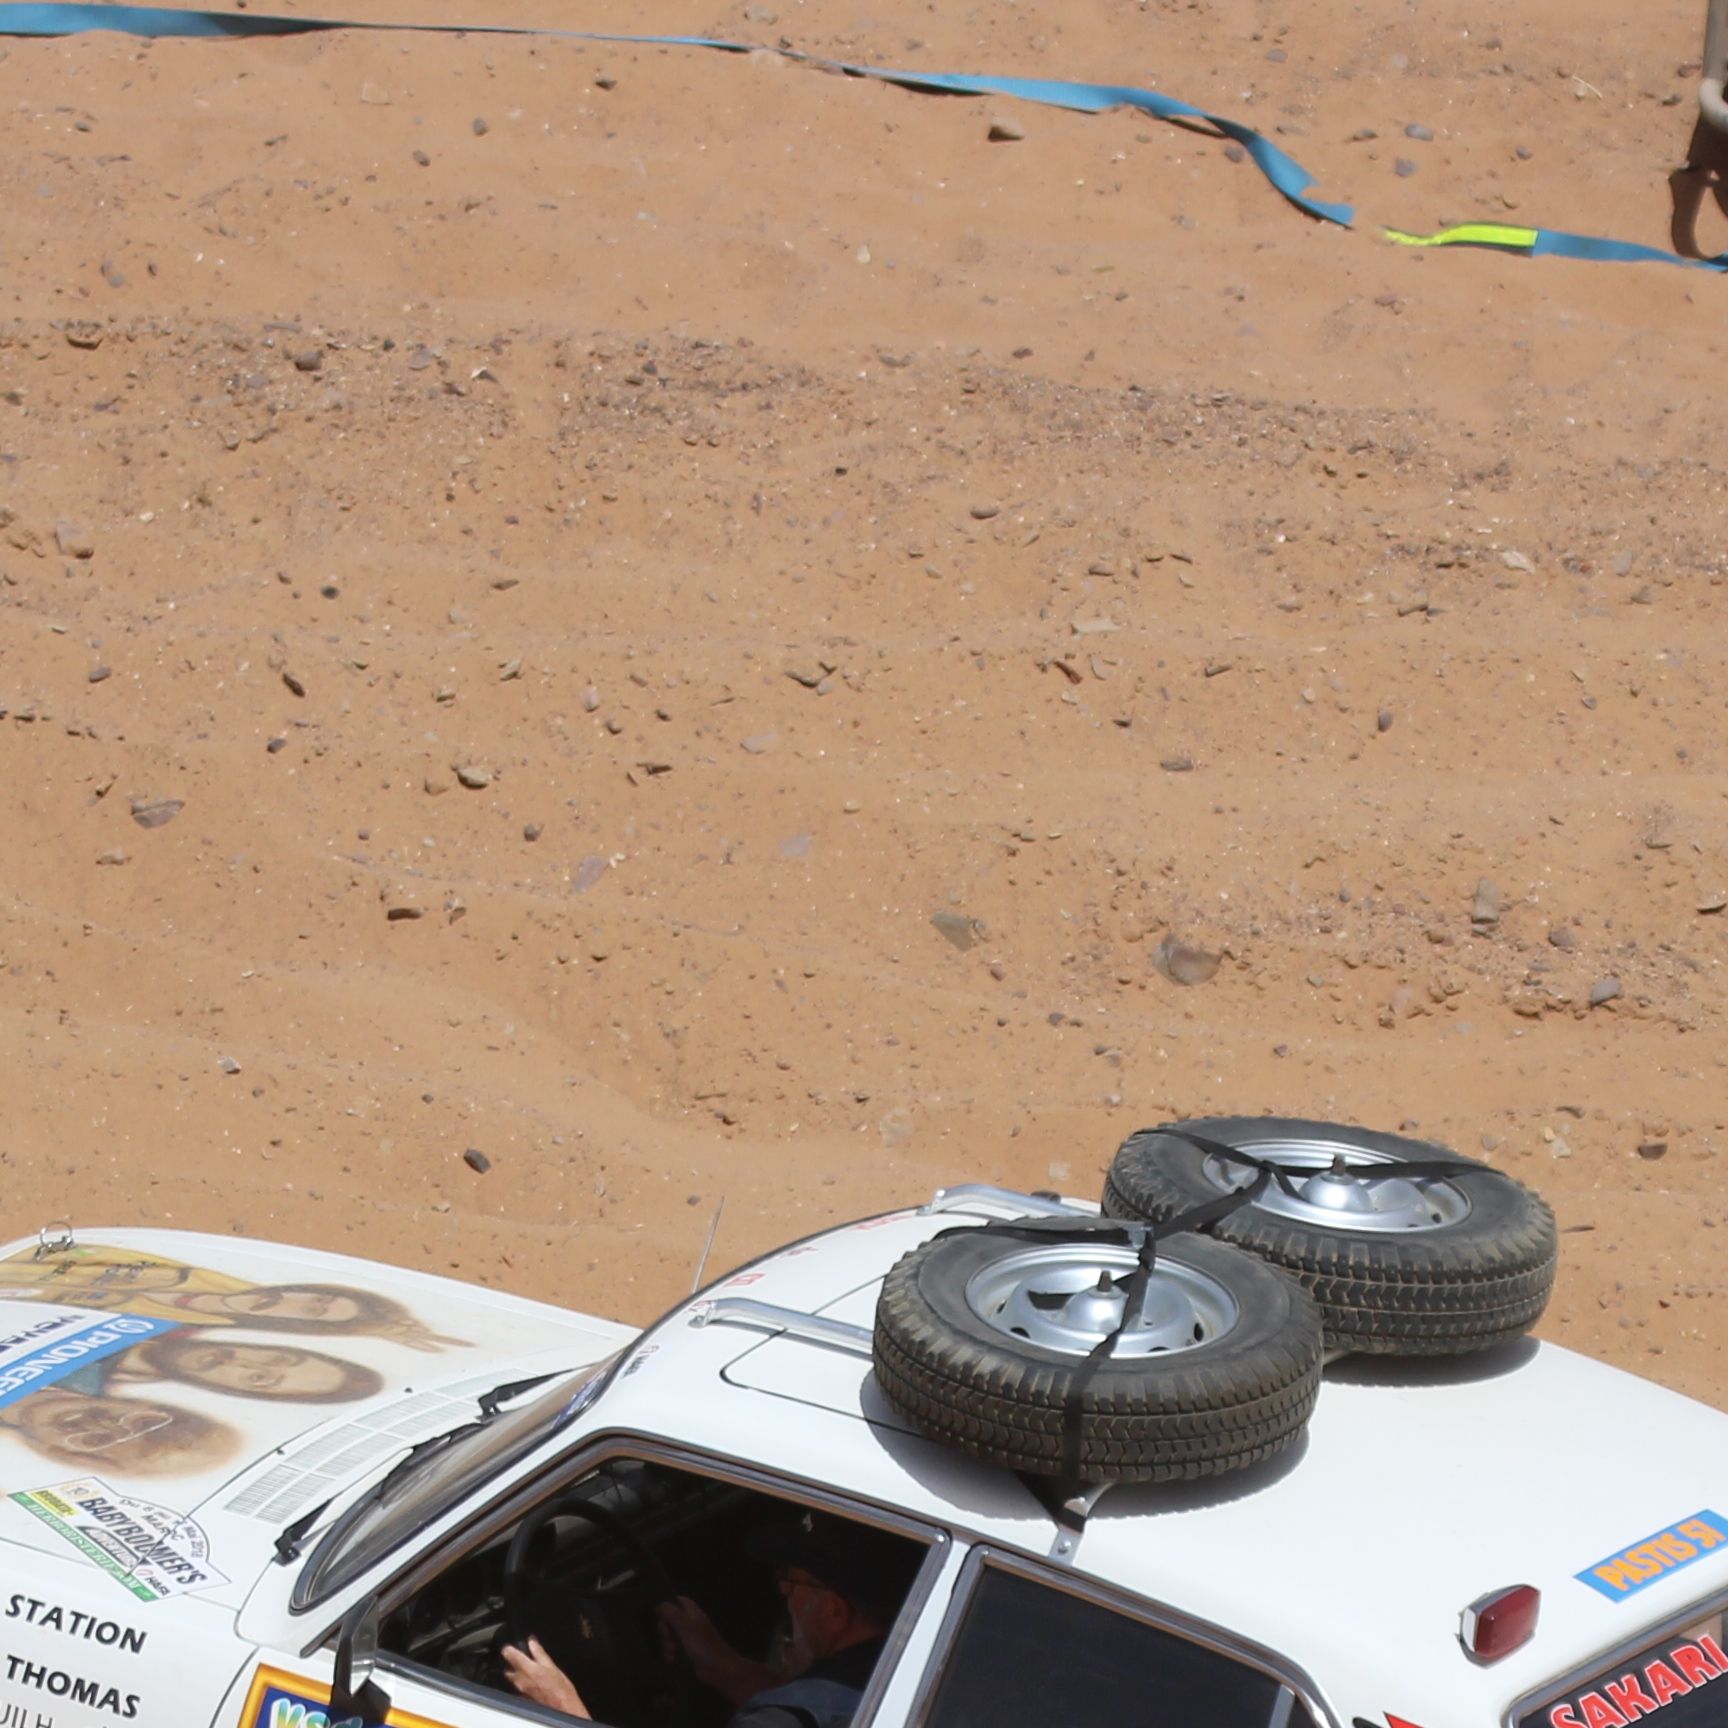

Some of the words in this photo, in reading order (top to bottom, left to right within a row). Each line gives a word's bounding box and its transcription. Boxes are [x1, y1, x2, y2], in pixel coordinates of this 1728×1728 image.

[77, 1496, 208, 1585] BABYBOOMER'S
[1591, 1530, 1693, 1592] PASTIS
[1685, 1520, 1728, 1552] 51
[4, 1594, 148, 1655] STATION
[5, 1654, 141, 1719] THOMAS
